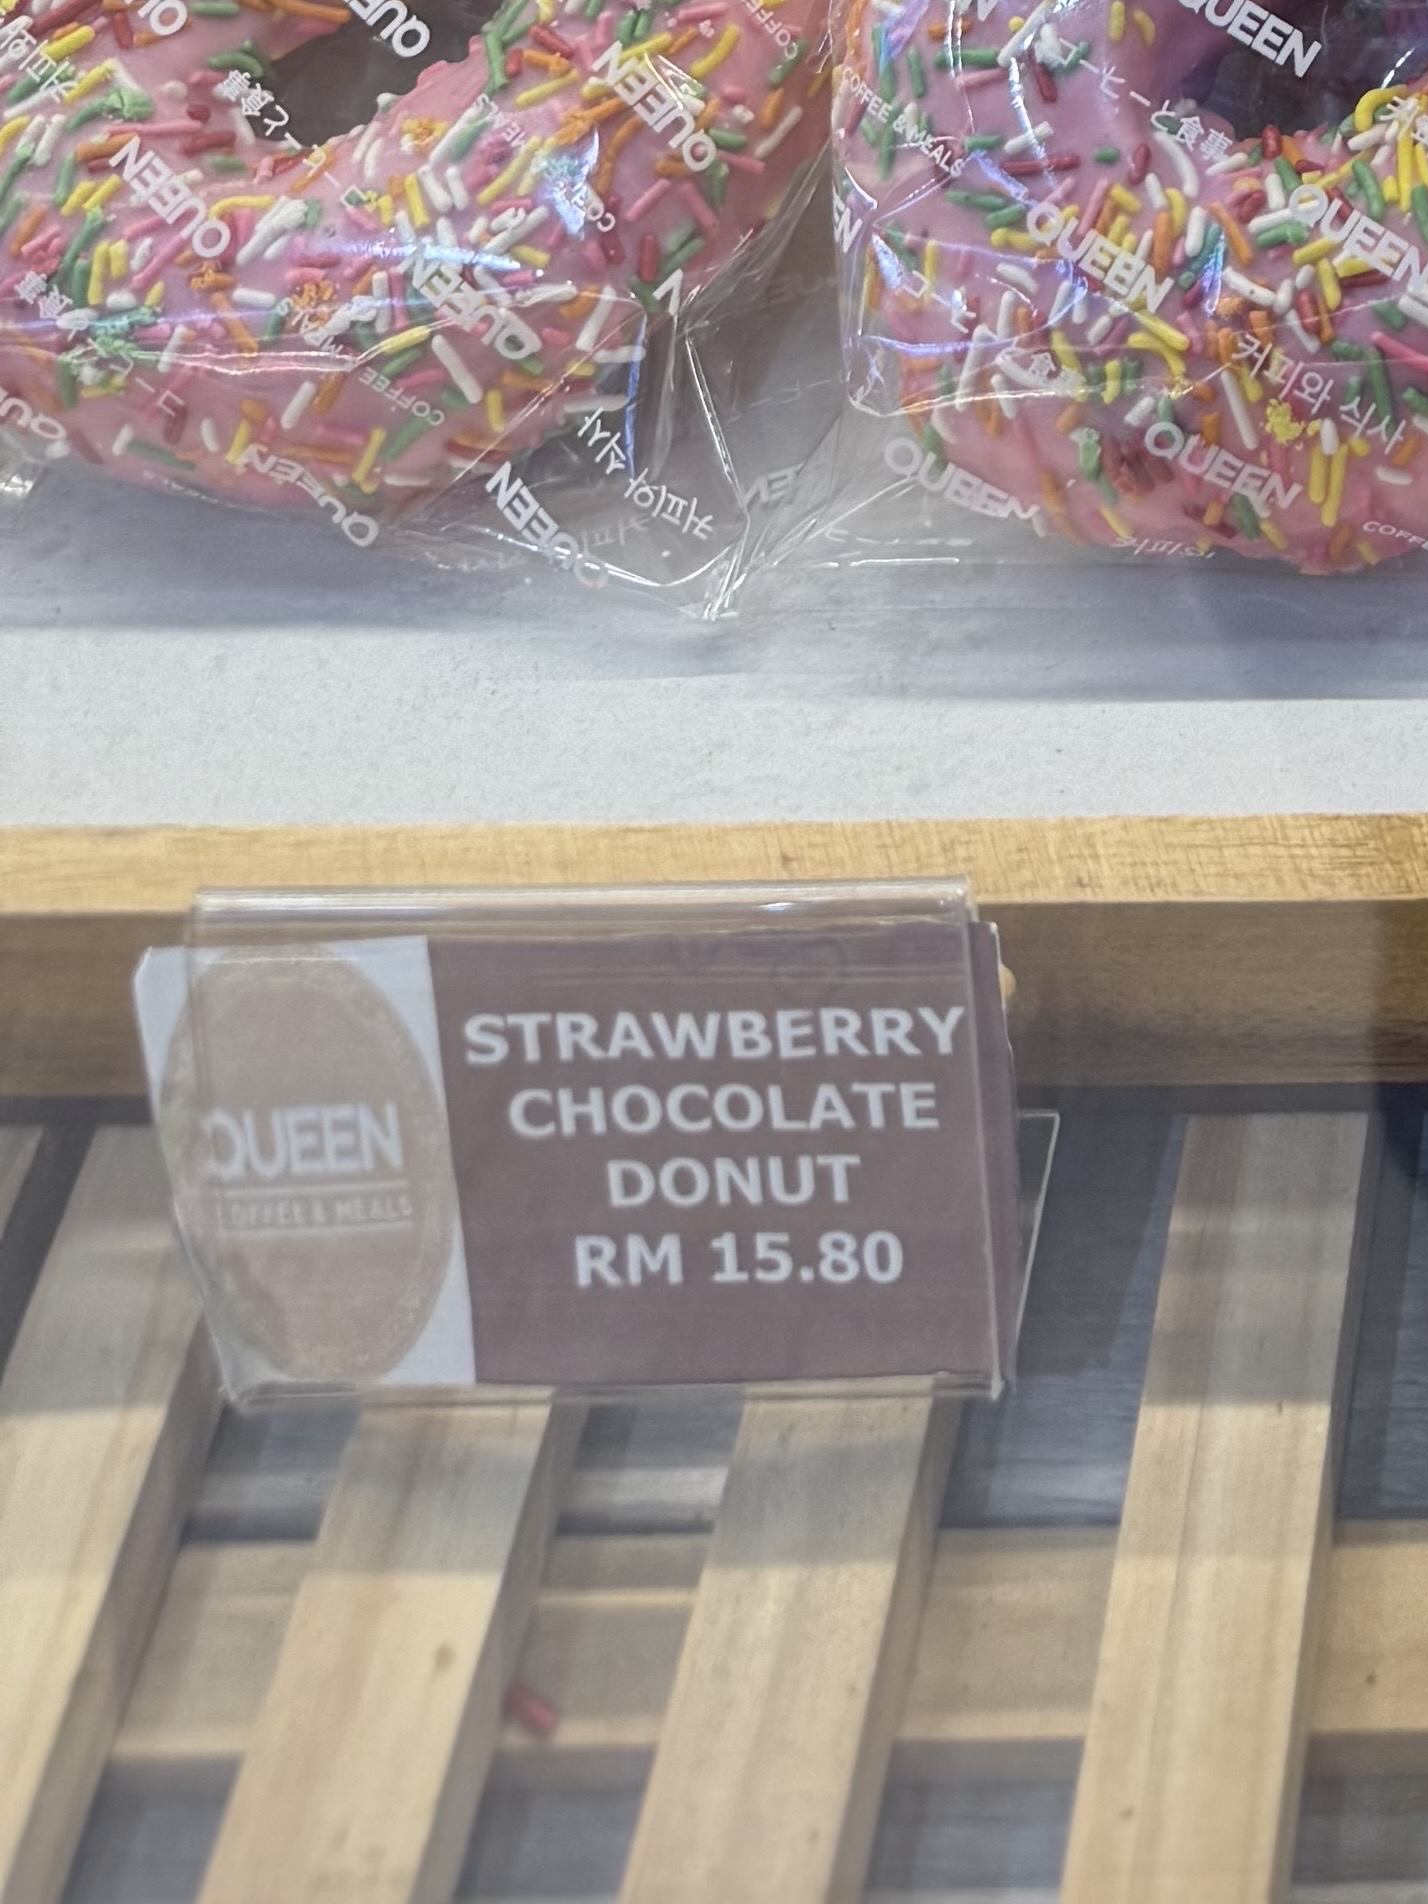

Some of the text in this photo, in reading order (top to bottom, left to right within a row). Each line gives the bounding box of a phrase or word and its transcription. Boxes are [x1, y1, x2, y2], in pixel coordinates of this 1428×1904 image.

[592, 39, 716, 172] QUEEN
[841, 66, 966, 177] COFFEE MEALS
[1055, 36, 1234, 161] コーヒーと食事
[109, 136, 231, 258] QUEEN
[1026, 203, 1174, 314] QUEEN
[360, 367, 445, 426] COFFEE
[1232, 334, 1406, 454] 커피와 식사
[238, 443, 378, 546] QUEEN
[577, 406, 713, 540] 커피와 식사
[885, 437, 1040, 520] QUEEN
[1144, 422, 1302, 509] QUEEN
[485, 460, 608, 588] QUEEN
[464, 1004, 965, 1065] STRAWBERRY
[201, 1102, 403, 1179] QUEEN
[508, 1080, 941, 1140] CHOCOLATE
[608, 1154, 861, 1209] DONUT
[574, 1230, 904, 1290] RM 15.80
